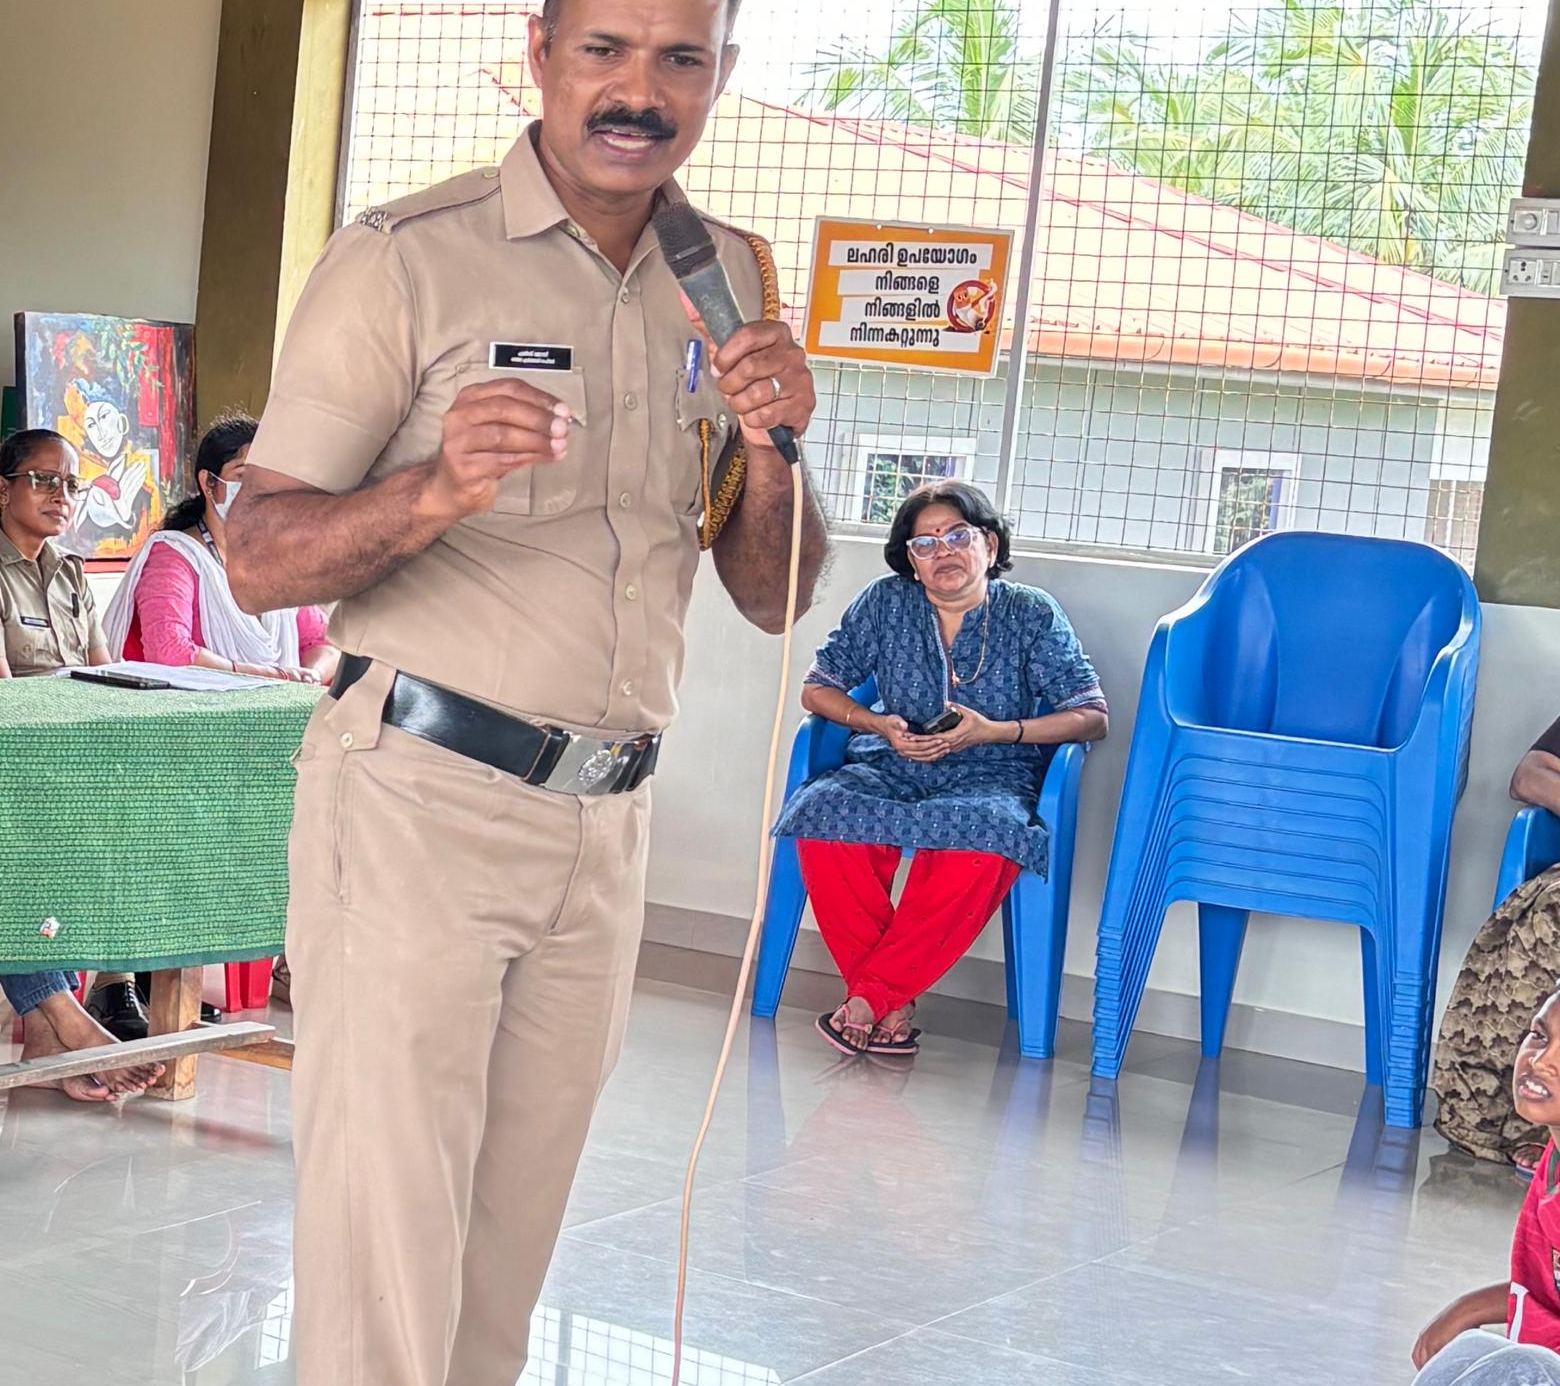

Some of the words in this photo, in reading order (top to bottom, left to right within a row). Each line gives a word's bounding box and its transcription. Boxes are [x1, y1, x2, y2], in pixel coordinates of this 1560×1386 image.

[847, 242, 894, 264] ലഹരി
[896, 247, 977, 267] ഉപയോഗം
[875, 270, 940, 295] നിങ്ങളെ
